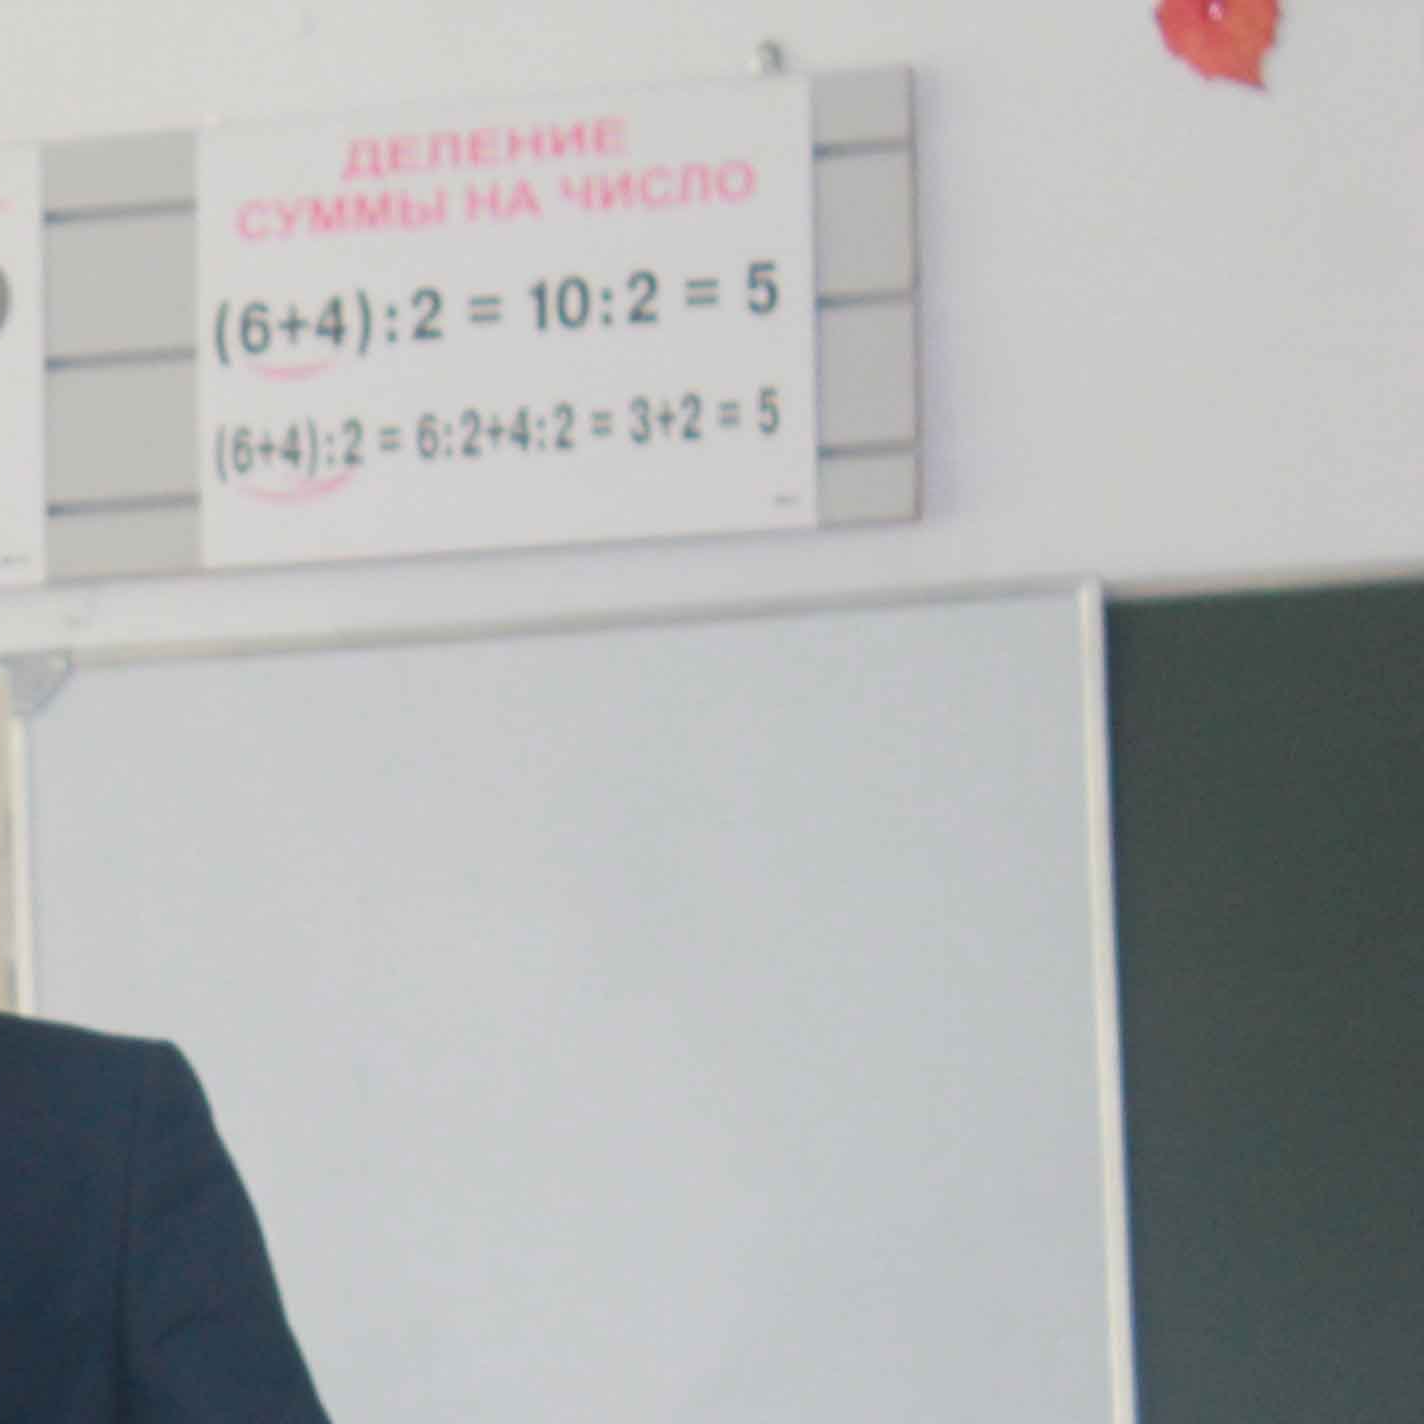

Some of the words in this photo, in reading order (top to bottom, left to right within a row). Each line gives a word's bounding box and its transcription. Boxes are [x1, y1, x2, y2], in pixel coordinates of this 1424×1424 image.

[342, 116, 629, 182] ДЕЛЕНИЕ
[235, 186, 449, 242] СУММЫ
[465, 178, 542, 222] НА
[559, 160, 760, 212] ЧИСЛО
[747, 259, 780, 317] 5
[757, 386, 781, 437] 5
